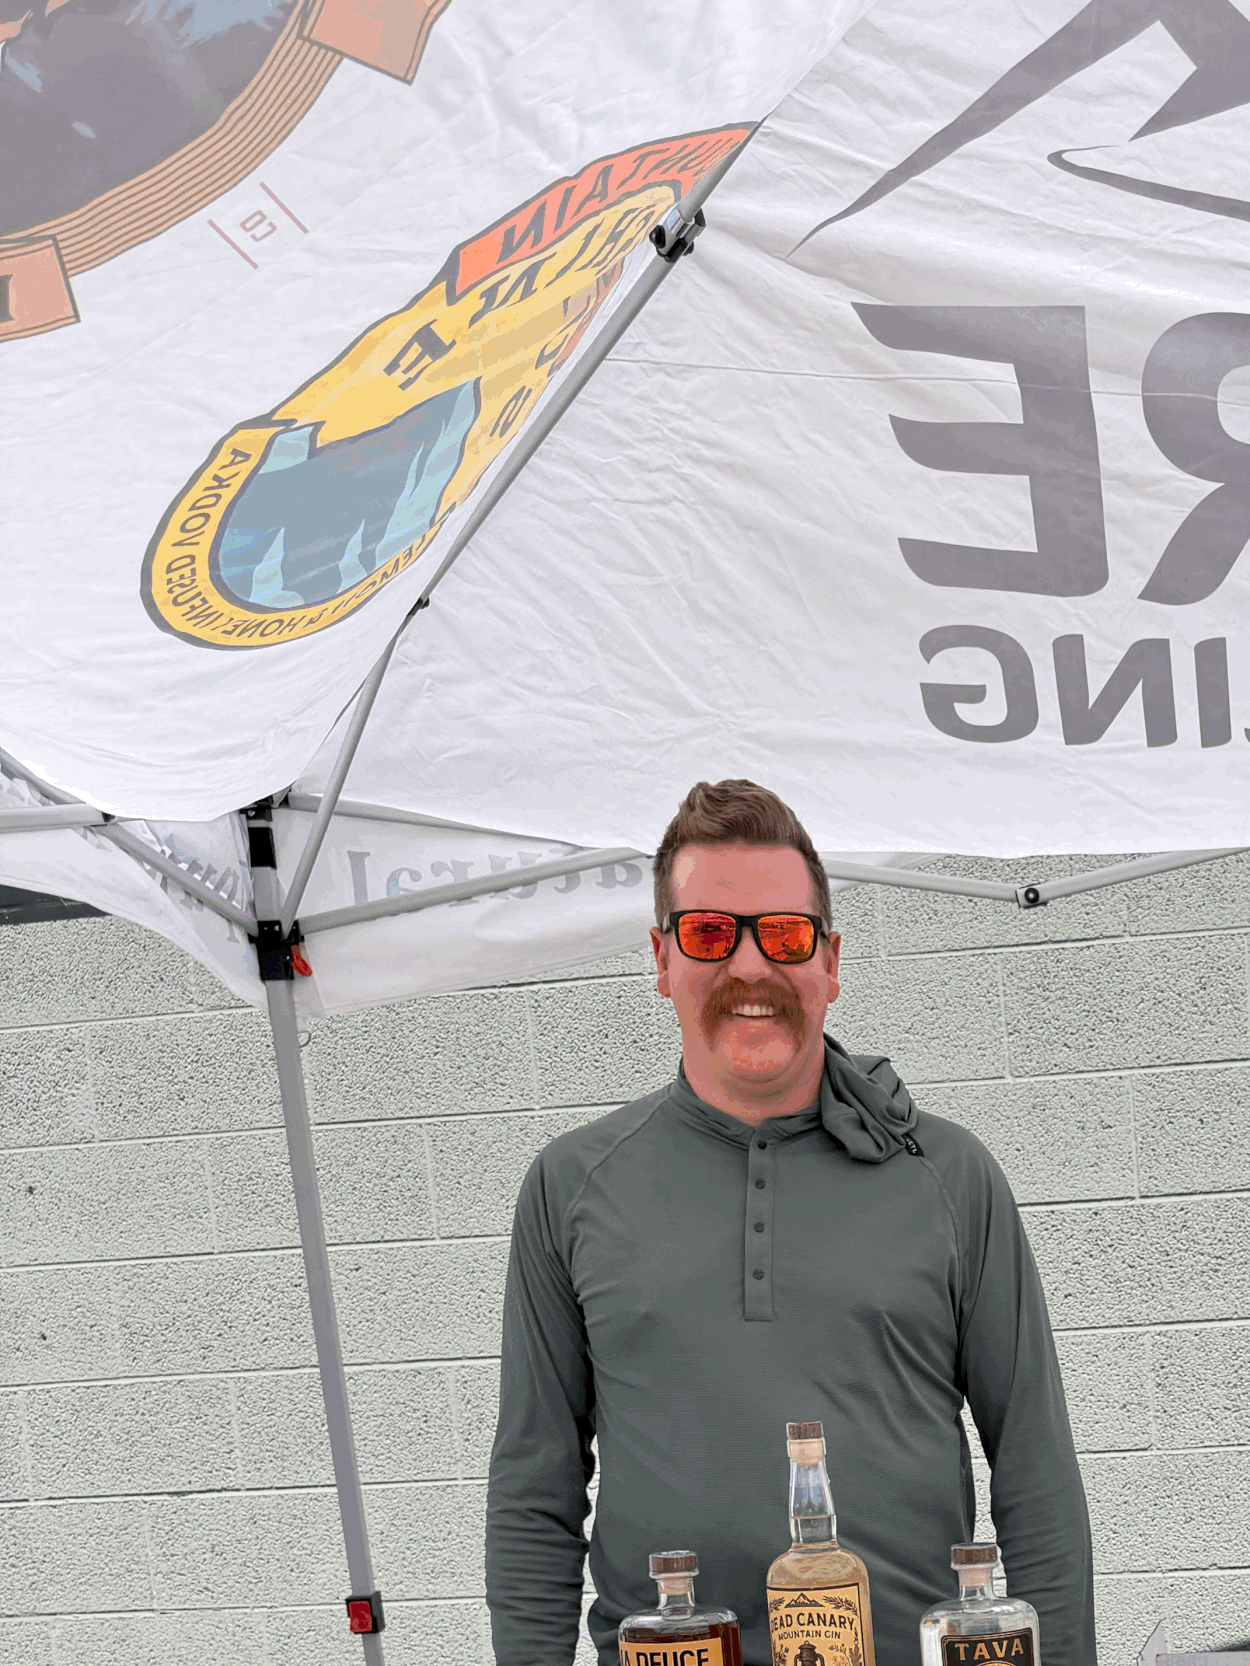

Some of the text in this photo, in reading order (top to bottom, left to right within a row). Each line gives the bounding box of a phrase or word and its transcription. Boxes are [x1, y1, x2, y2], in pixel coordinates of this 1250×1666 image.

[797, 1612, 855, 1631] CANARY
[778, 1630, 841, 1641] MOUNTAIN GIN
[954, 1638, 1024, 1661] TAVA
